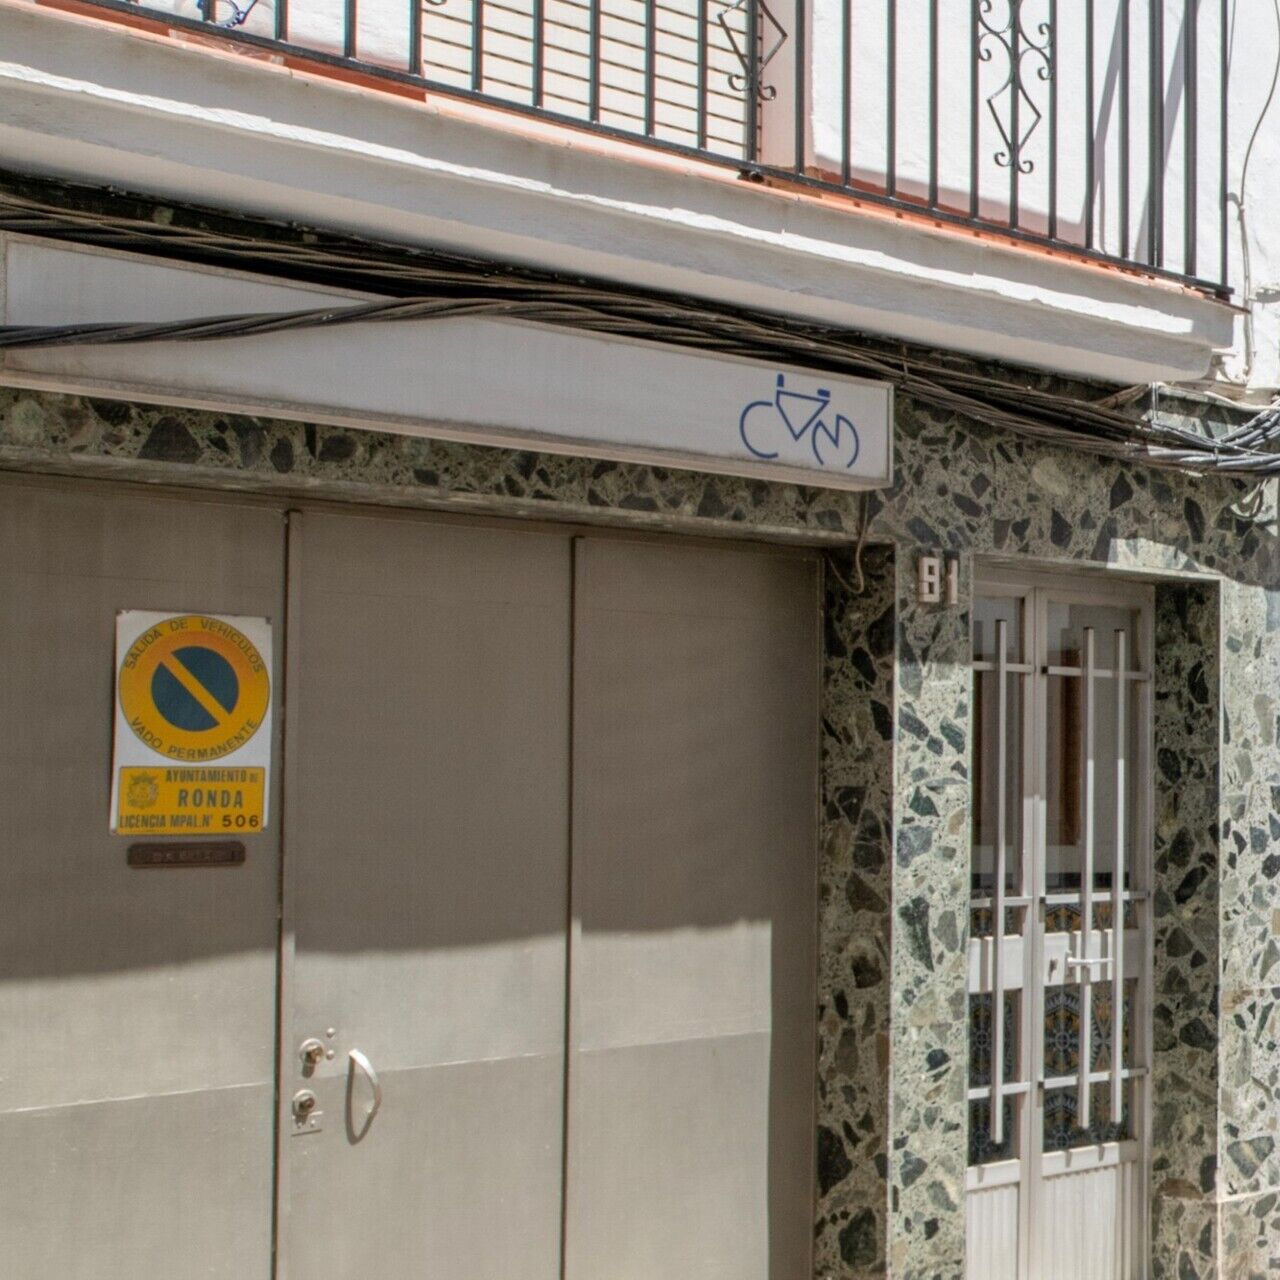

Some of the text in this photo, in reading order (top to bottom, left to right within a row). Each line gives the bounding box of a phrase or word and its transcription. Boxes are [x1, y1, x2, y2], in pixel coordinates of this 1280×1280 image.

[125, 619, 264, 673] SALIDA DE VEHICULOS
[131, 716, 258, 758] VADO PERMANENTE
[165, 769, 247, 782] AYUNTAMIENTO
[178, 788, 243, 808] RONDA
[119, 814, 166, 829] LICENCIA
[222, 814, 259, 828] 506
